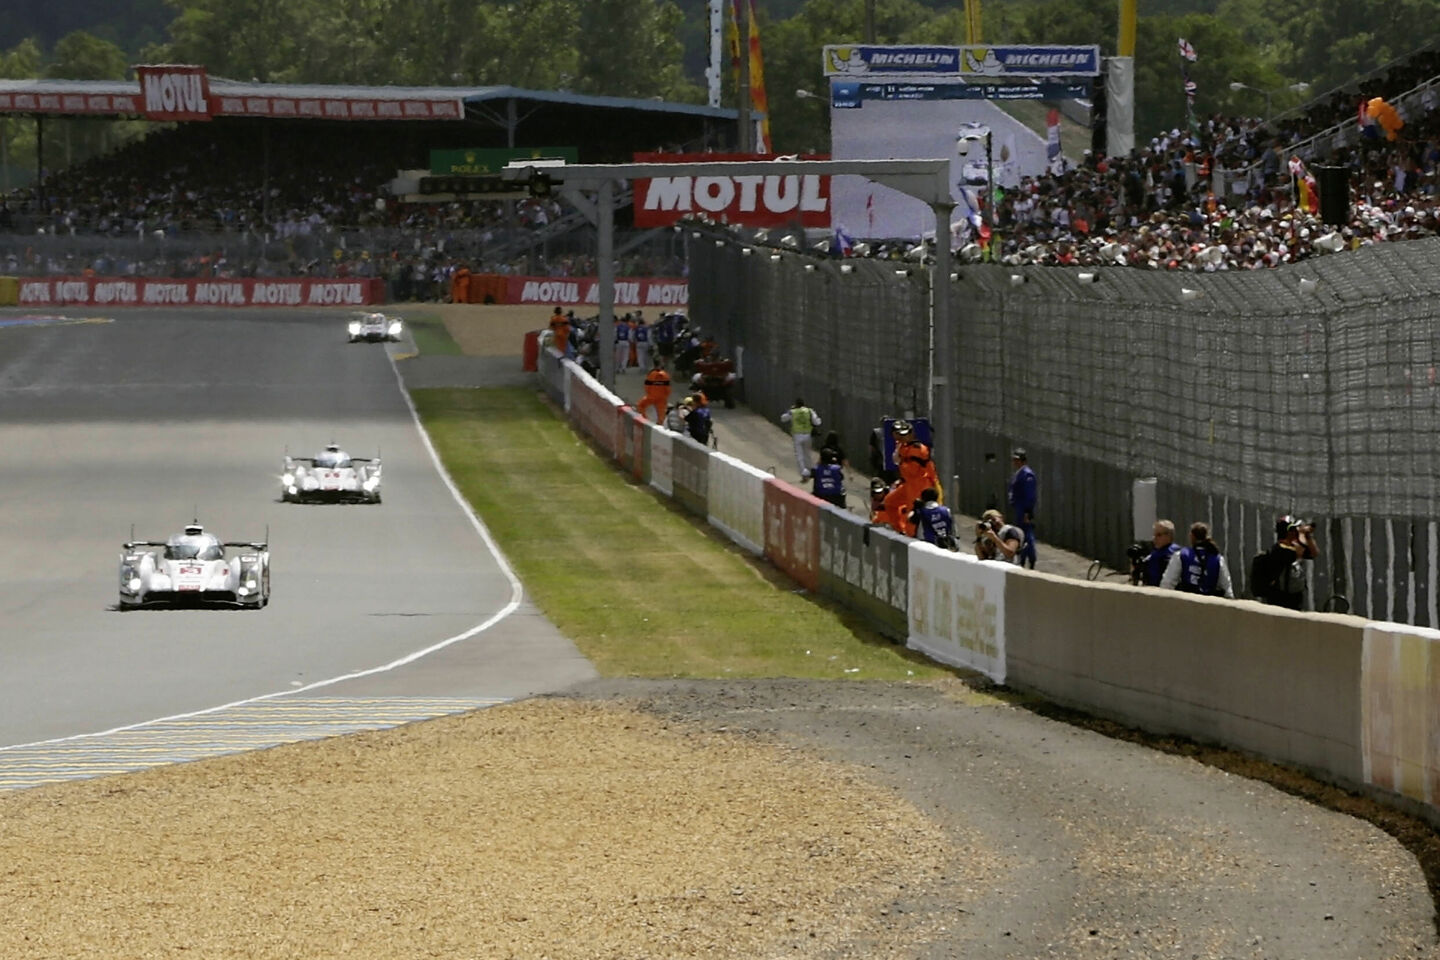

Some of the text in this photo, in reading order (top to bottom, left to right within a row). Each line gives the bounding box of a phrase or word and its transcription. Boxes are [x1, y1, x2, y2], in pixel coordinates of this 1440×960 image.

[870, 53, 955, 65] MICHELIN
[1005, 53, 1090, 65] MICHELIN
[144, 73, 208, 113] MOTUL
[643, 174, 828, 214] MOTUL
[143, 282, 189, 303] MOTUL
[194, 282, 246, 304] MOTUL
[251, 282, 302, 304] MOTUL
[308, 283, 364, 304] MOTUL
[520, 281, 689, 304] MOTUL MTUL MOTU
